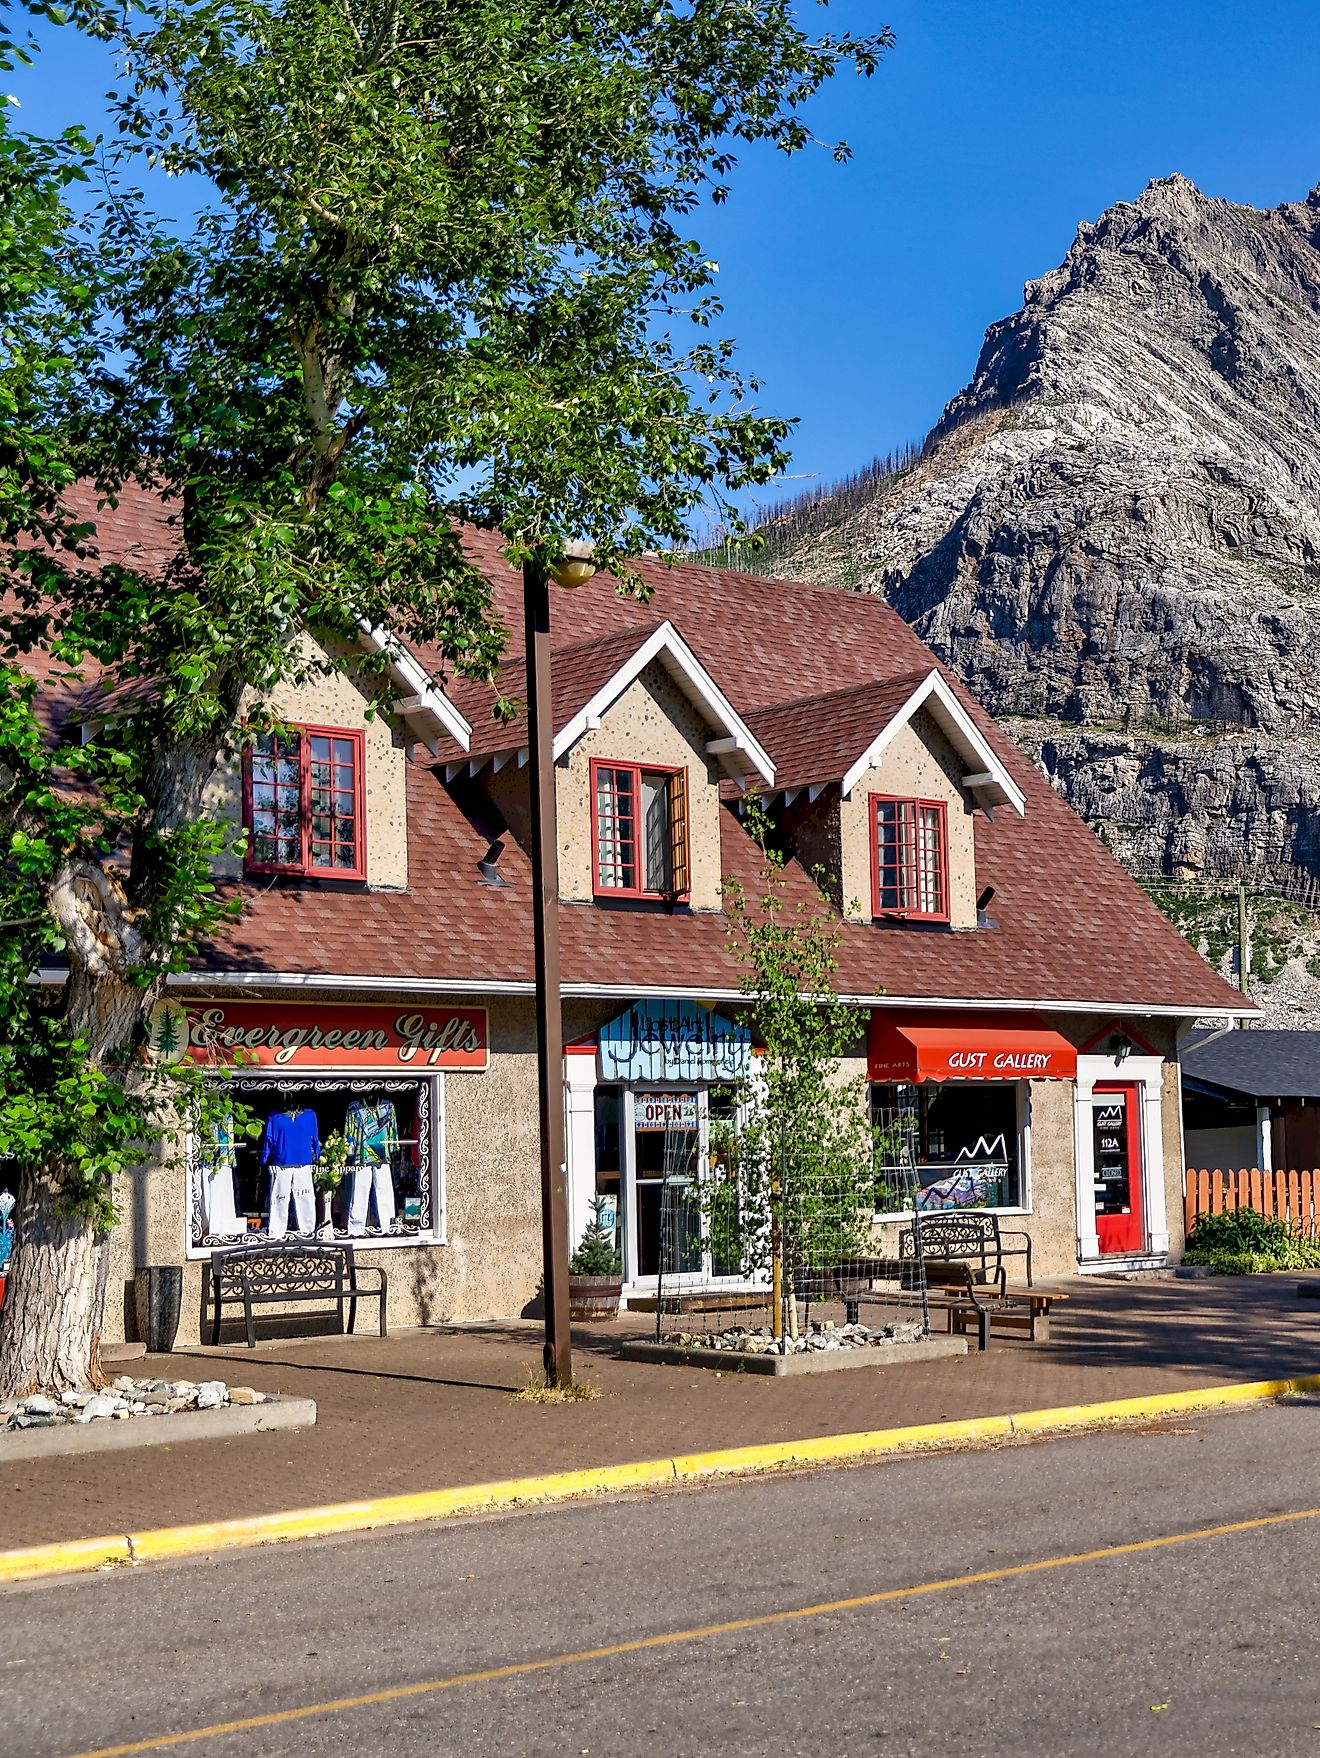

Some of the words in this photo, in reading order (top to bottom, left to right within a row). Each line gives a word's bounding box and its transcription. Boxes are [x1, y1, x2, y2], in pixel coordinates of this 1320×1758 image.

[641, 1015, 675, 1032] Lost
[680, 1015, 705, 1032] Art
[189, 1008, 388, 1064] Evergreen
[393, 1013, 482, 1065] Gifts
[608, 1009, 745, 1074] Jewelry
[948, 1052, 988, 1068] GUST
[993, 1053, 1052, 1069] GALLERY
[645, 1104, 682, 1121] OPEN
[1101, 1138, 1119, 1148] 112A
[976, 1167, 1008, 1177] GALLERY
